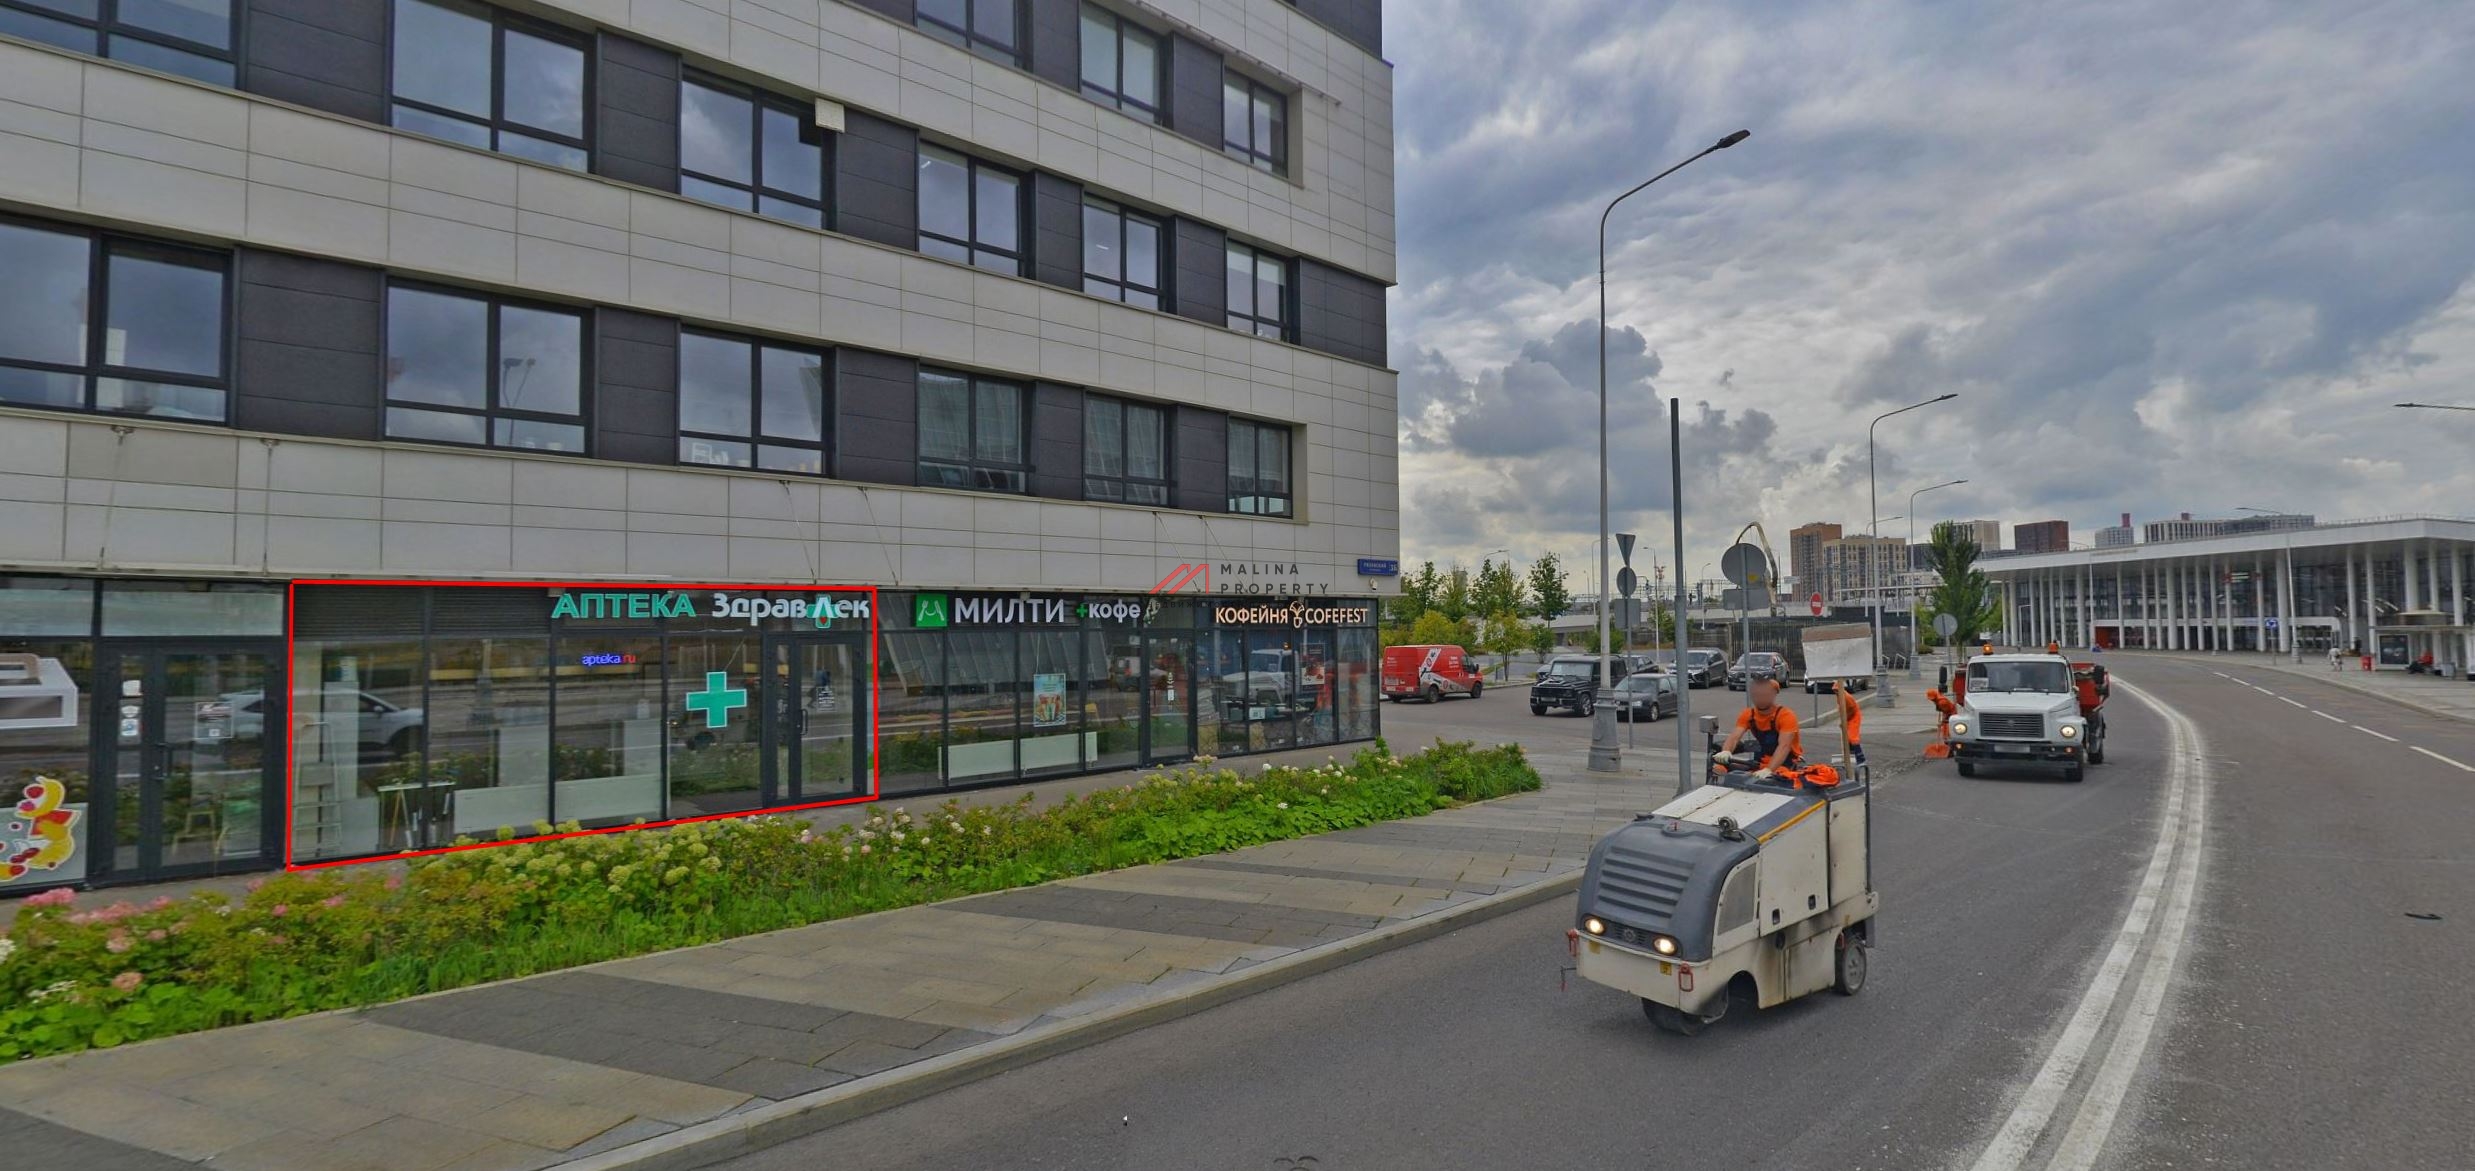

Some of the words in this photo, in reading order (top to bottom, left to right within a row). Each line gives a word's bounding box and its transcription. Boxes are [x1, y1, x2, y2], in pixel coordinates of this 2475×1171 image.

[551, 593, 696, 619] АПТЕКА
[954, 597, 1065, 624] МИЛТИ
[1215, 605, 1288, 624] КОФЕЙНЯ
[1304, 607, 1369, 624] COFEFEST
